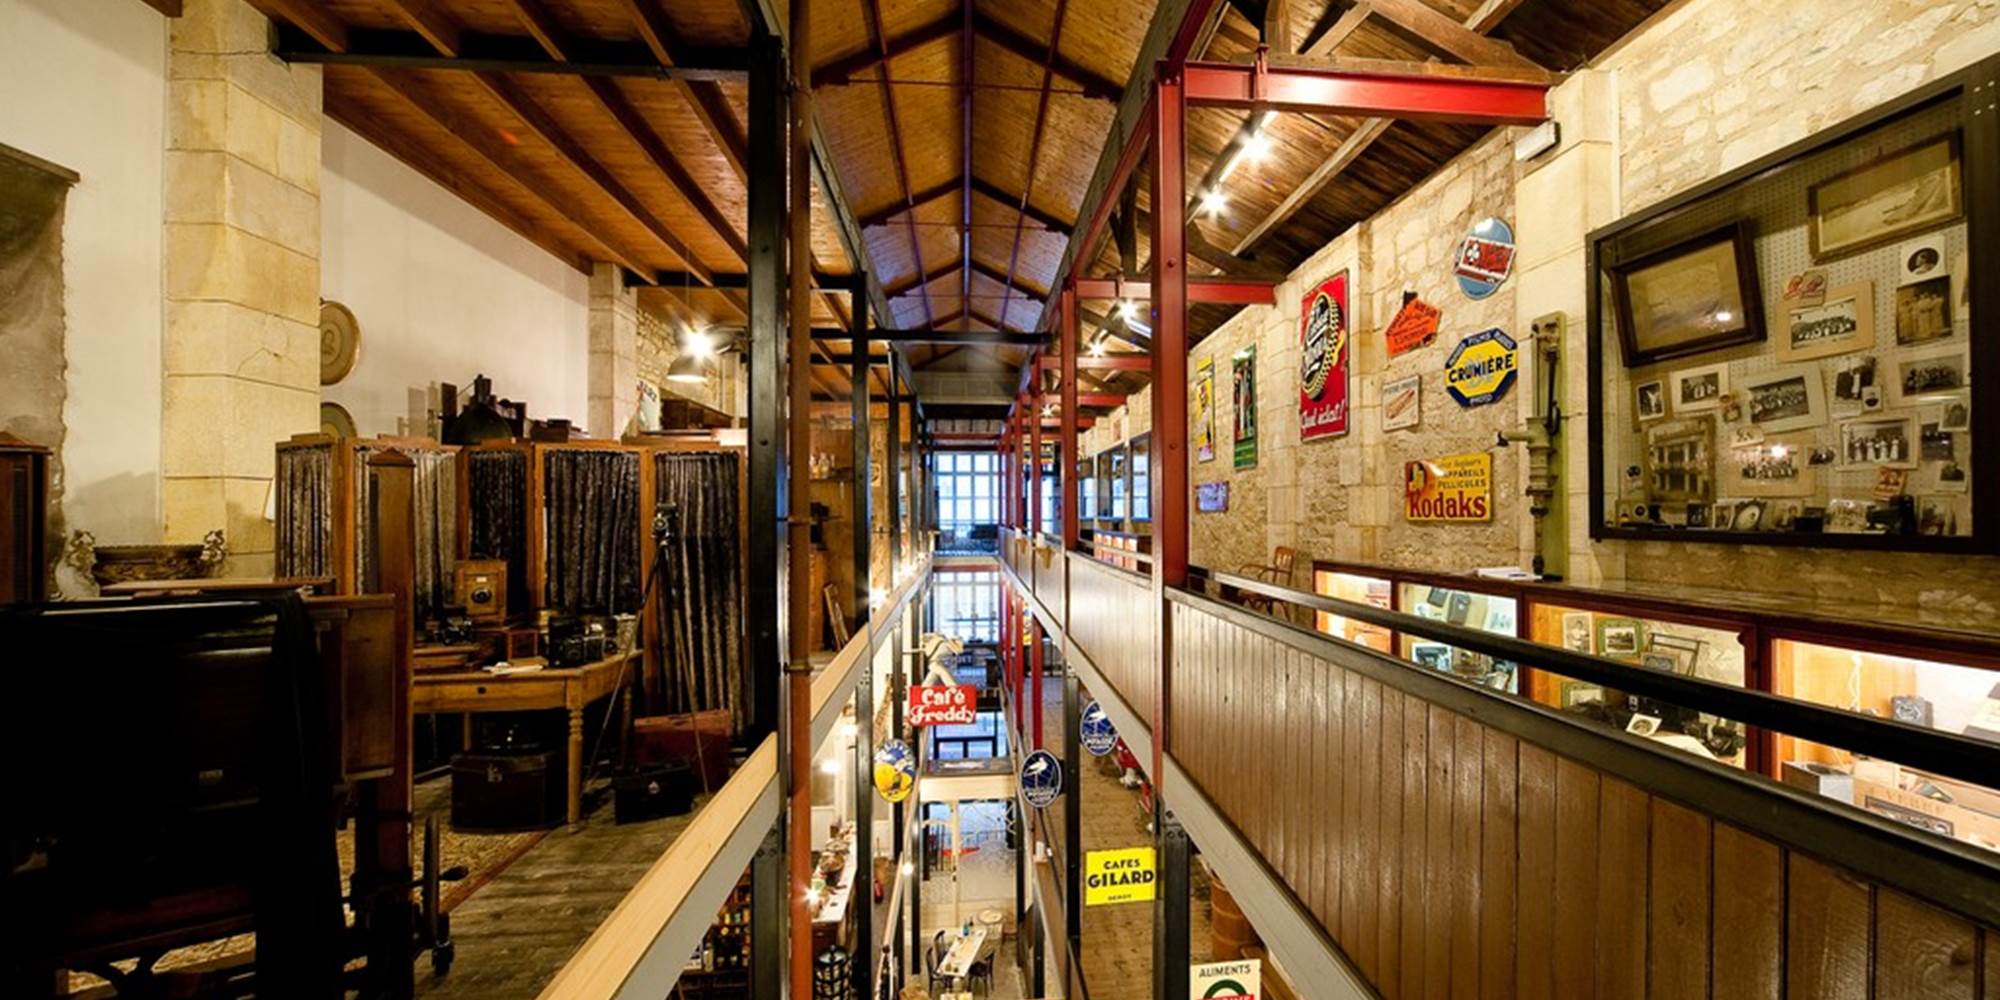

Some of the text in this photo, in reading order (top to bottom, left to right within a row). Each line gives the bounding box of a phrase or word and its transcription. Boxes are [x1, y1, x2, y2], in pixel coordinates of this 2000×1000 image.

[1408, 490, 1487, 518] Kodaks
[922, 687, 966, 706] Café
[910, 704, 975, 725] Freddy
[1104, 859, 1140, 870] CAFES
[1088, 870, 1154, 888] GILARD
[1199, 964, 1251, 978] ALIMENTS
